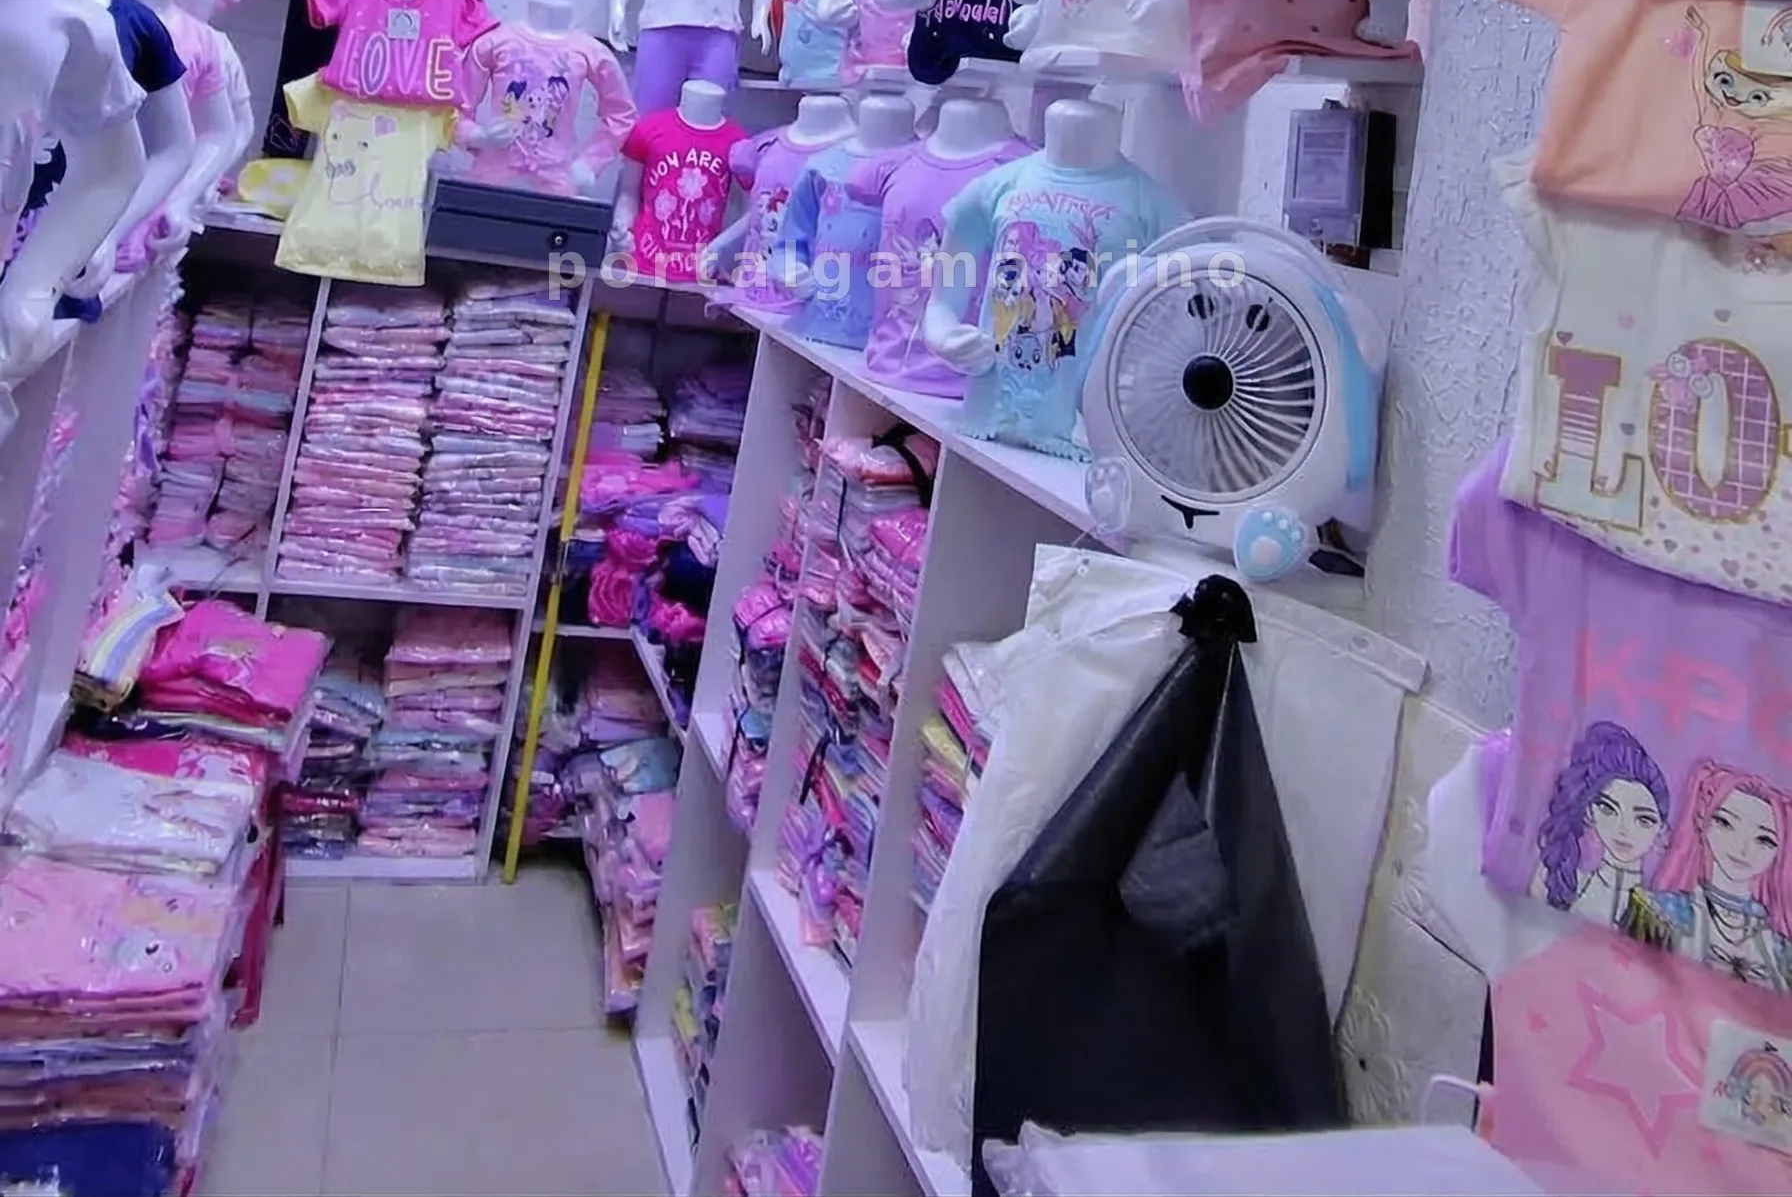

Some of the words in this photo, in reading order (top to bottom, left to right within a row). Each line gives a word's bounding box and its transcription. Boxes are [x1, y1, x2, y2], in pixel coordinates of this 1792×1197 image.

[340, 29, 454, 100] LOVE
[685, 147, 723, 176] ARE
[1533, 337, 1792, 533] LO
